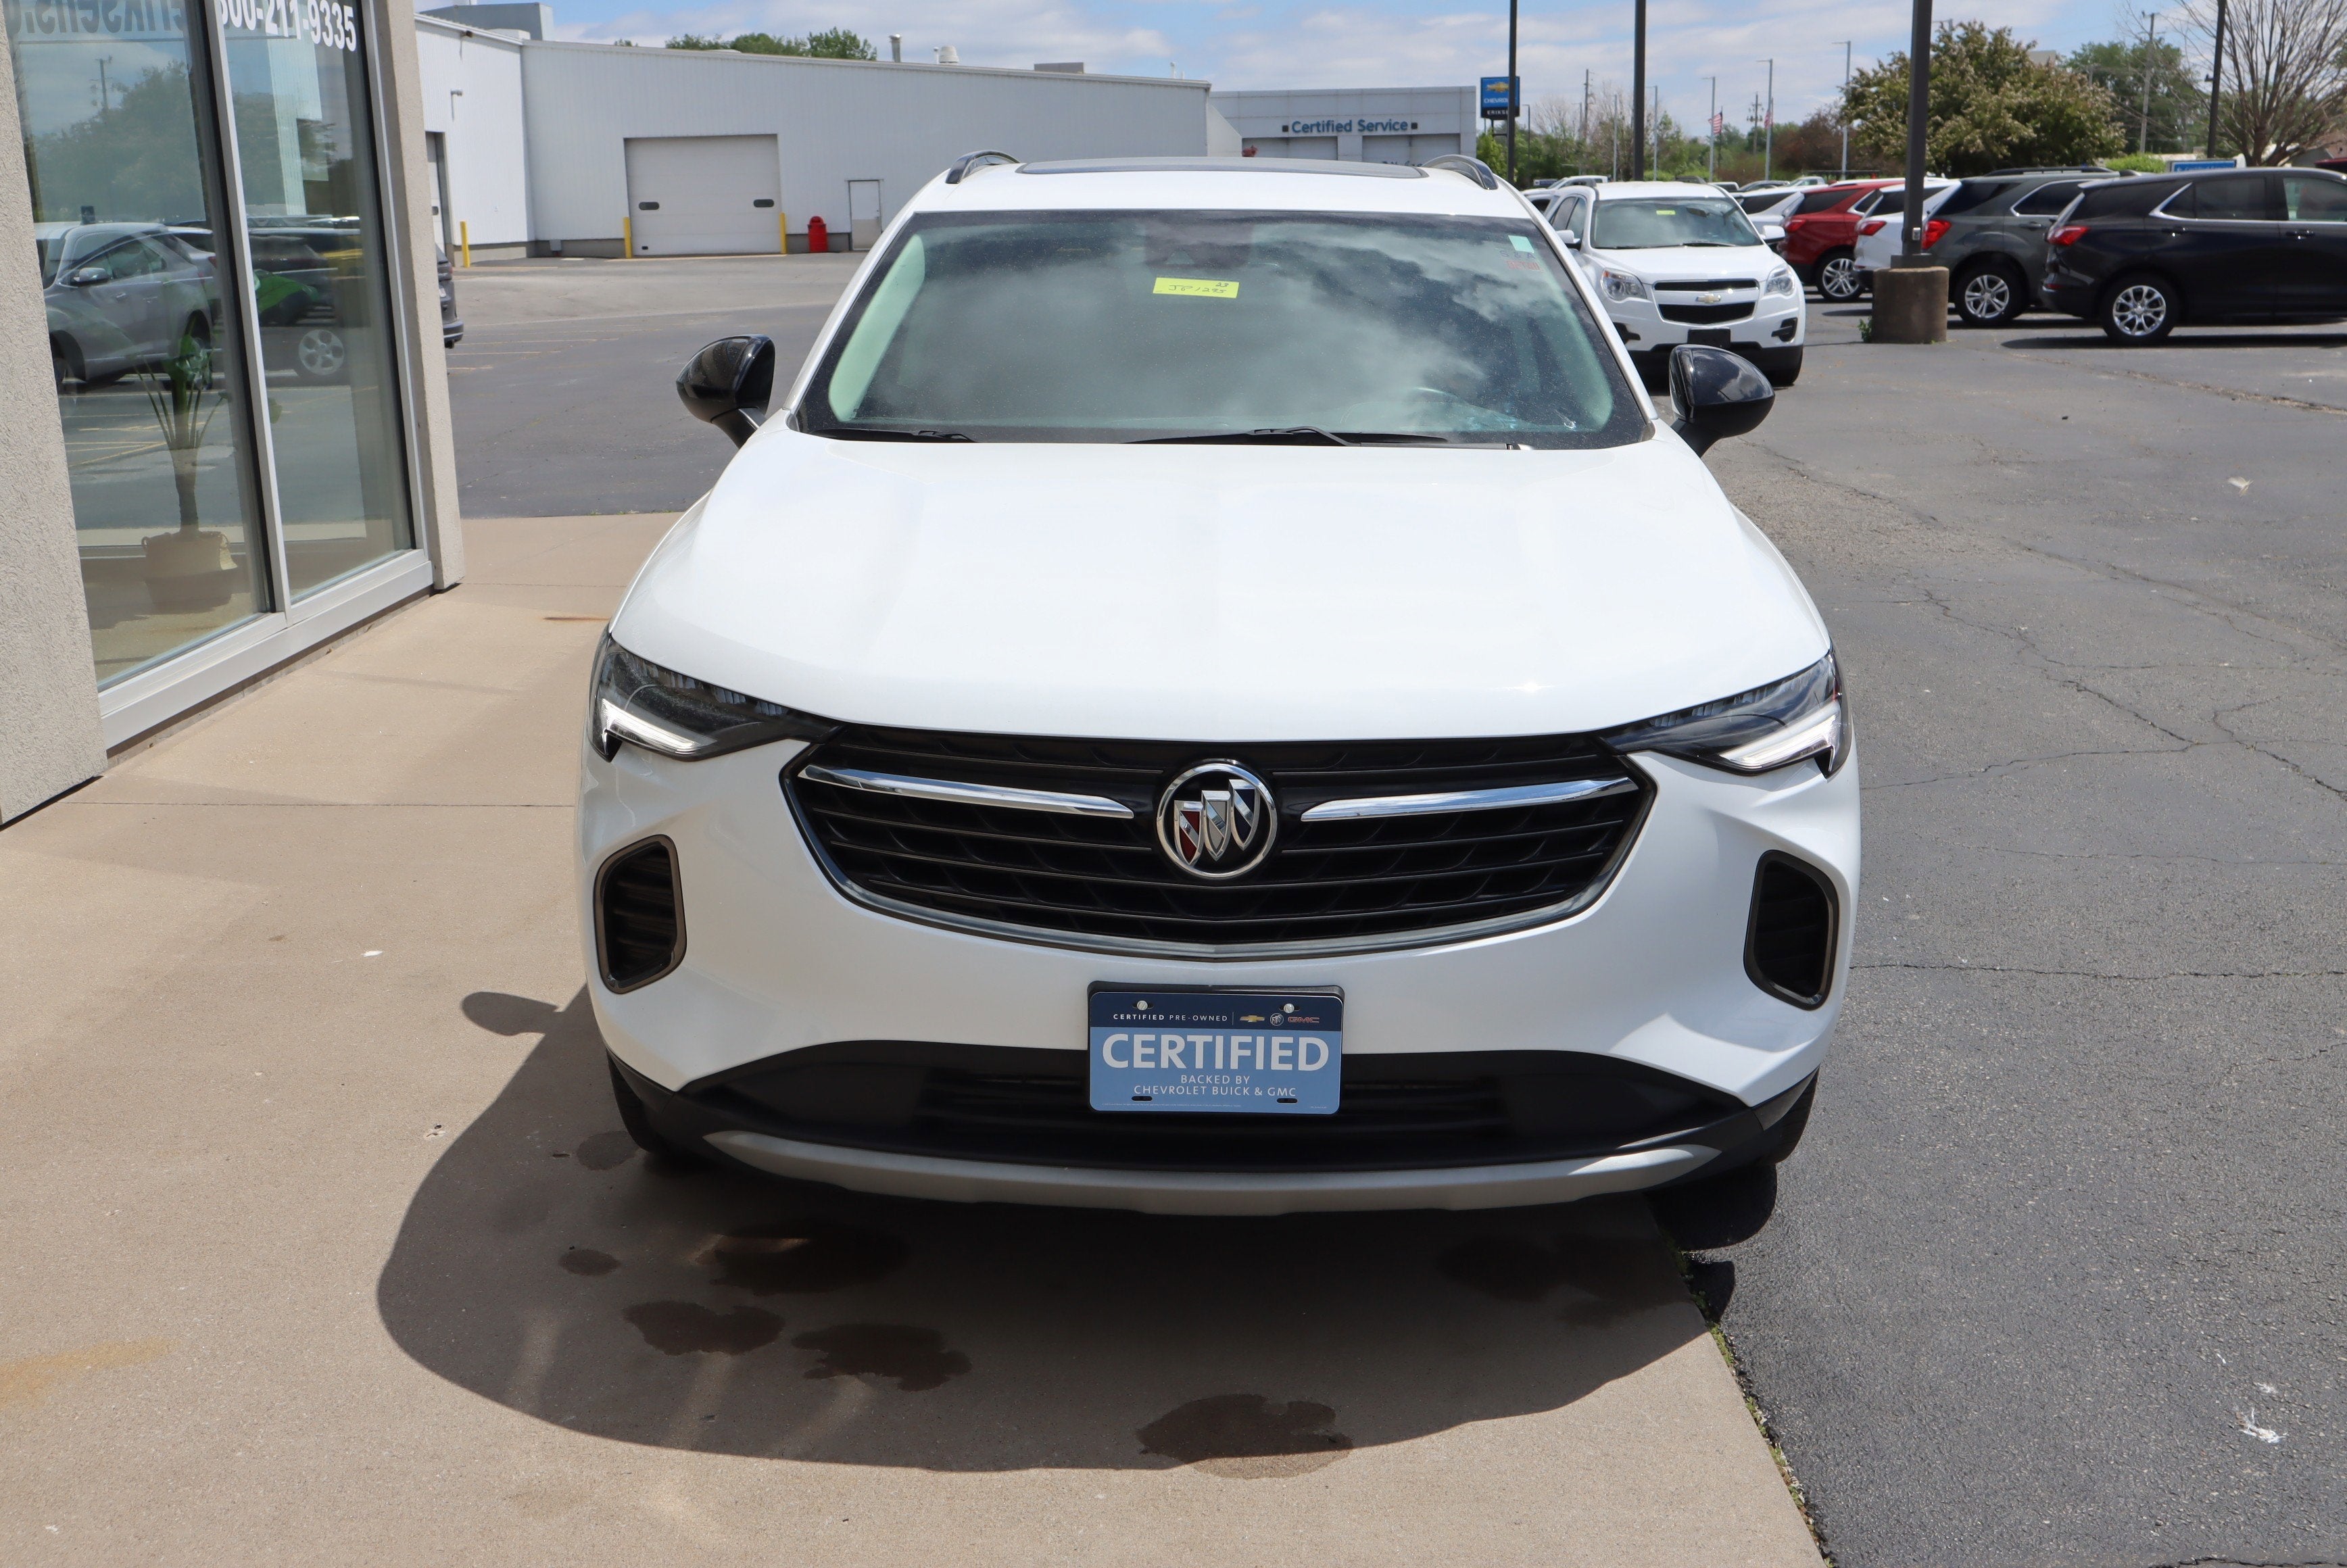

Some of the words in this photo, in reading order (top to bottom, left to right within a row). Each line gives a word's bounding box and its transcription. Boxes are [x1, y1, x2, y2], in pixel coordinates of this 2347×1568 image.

[1292, 120, 1352, 132] Certified
[1357, 118, 1408, 132] Service
[1103, 1033, 1329, 1071] CERTIFIED
[1181, 1075, 1230, 1084] BACKED
[1236, 1075, 1251, 1084] BY
[1134, 1085, 1207, 1095] CHEVROLET
[1213, 1086, 1250, 1096] BUICK
[1254, 1087, 1263, 1096] &
[1267, 1087, 1296, 1096] GMC
